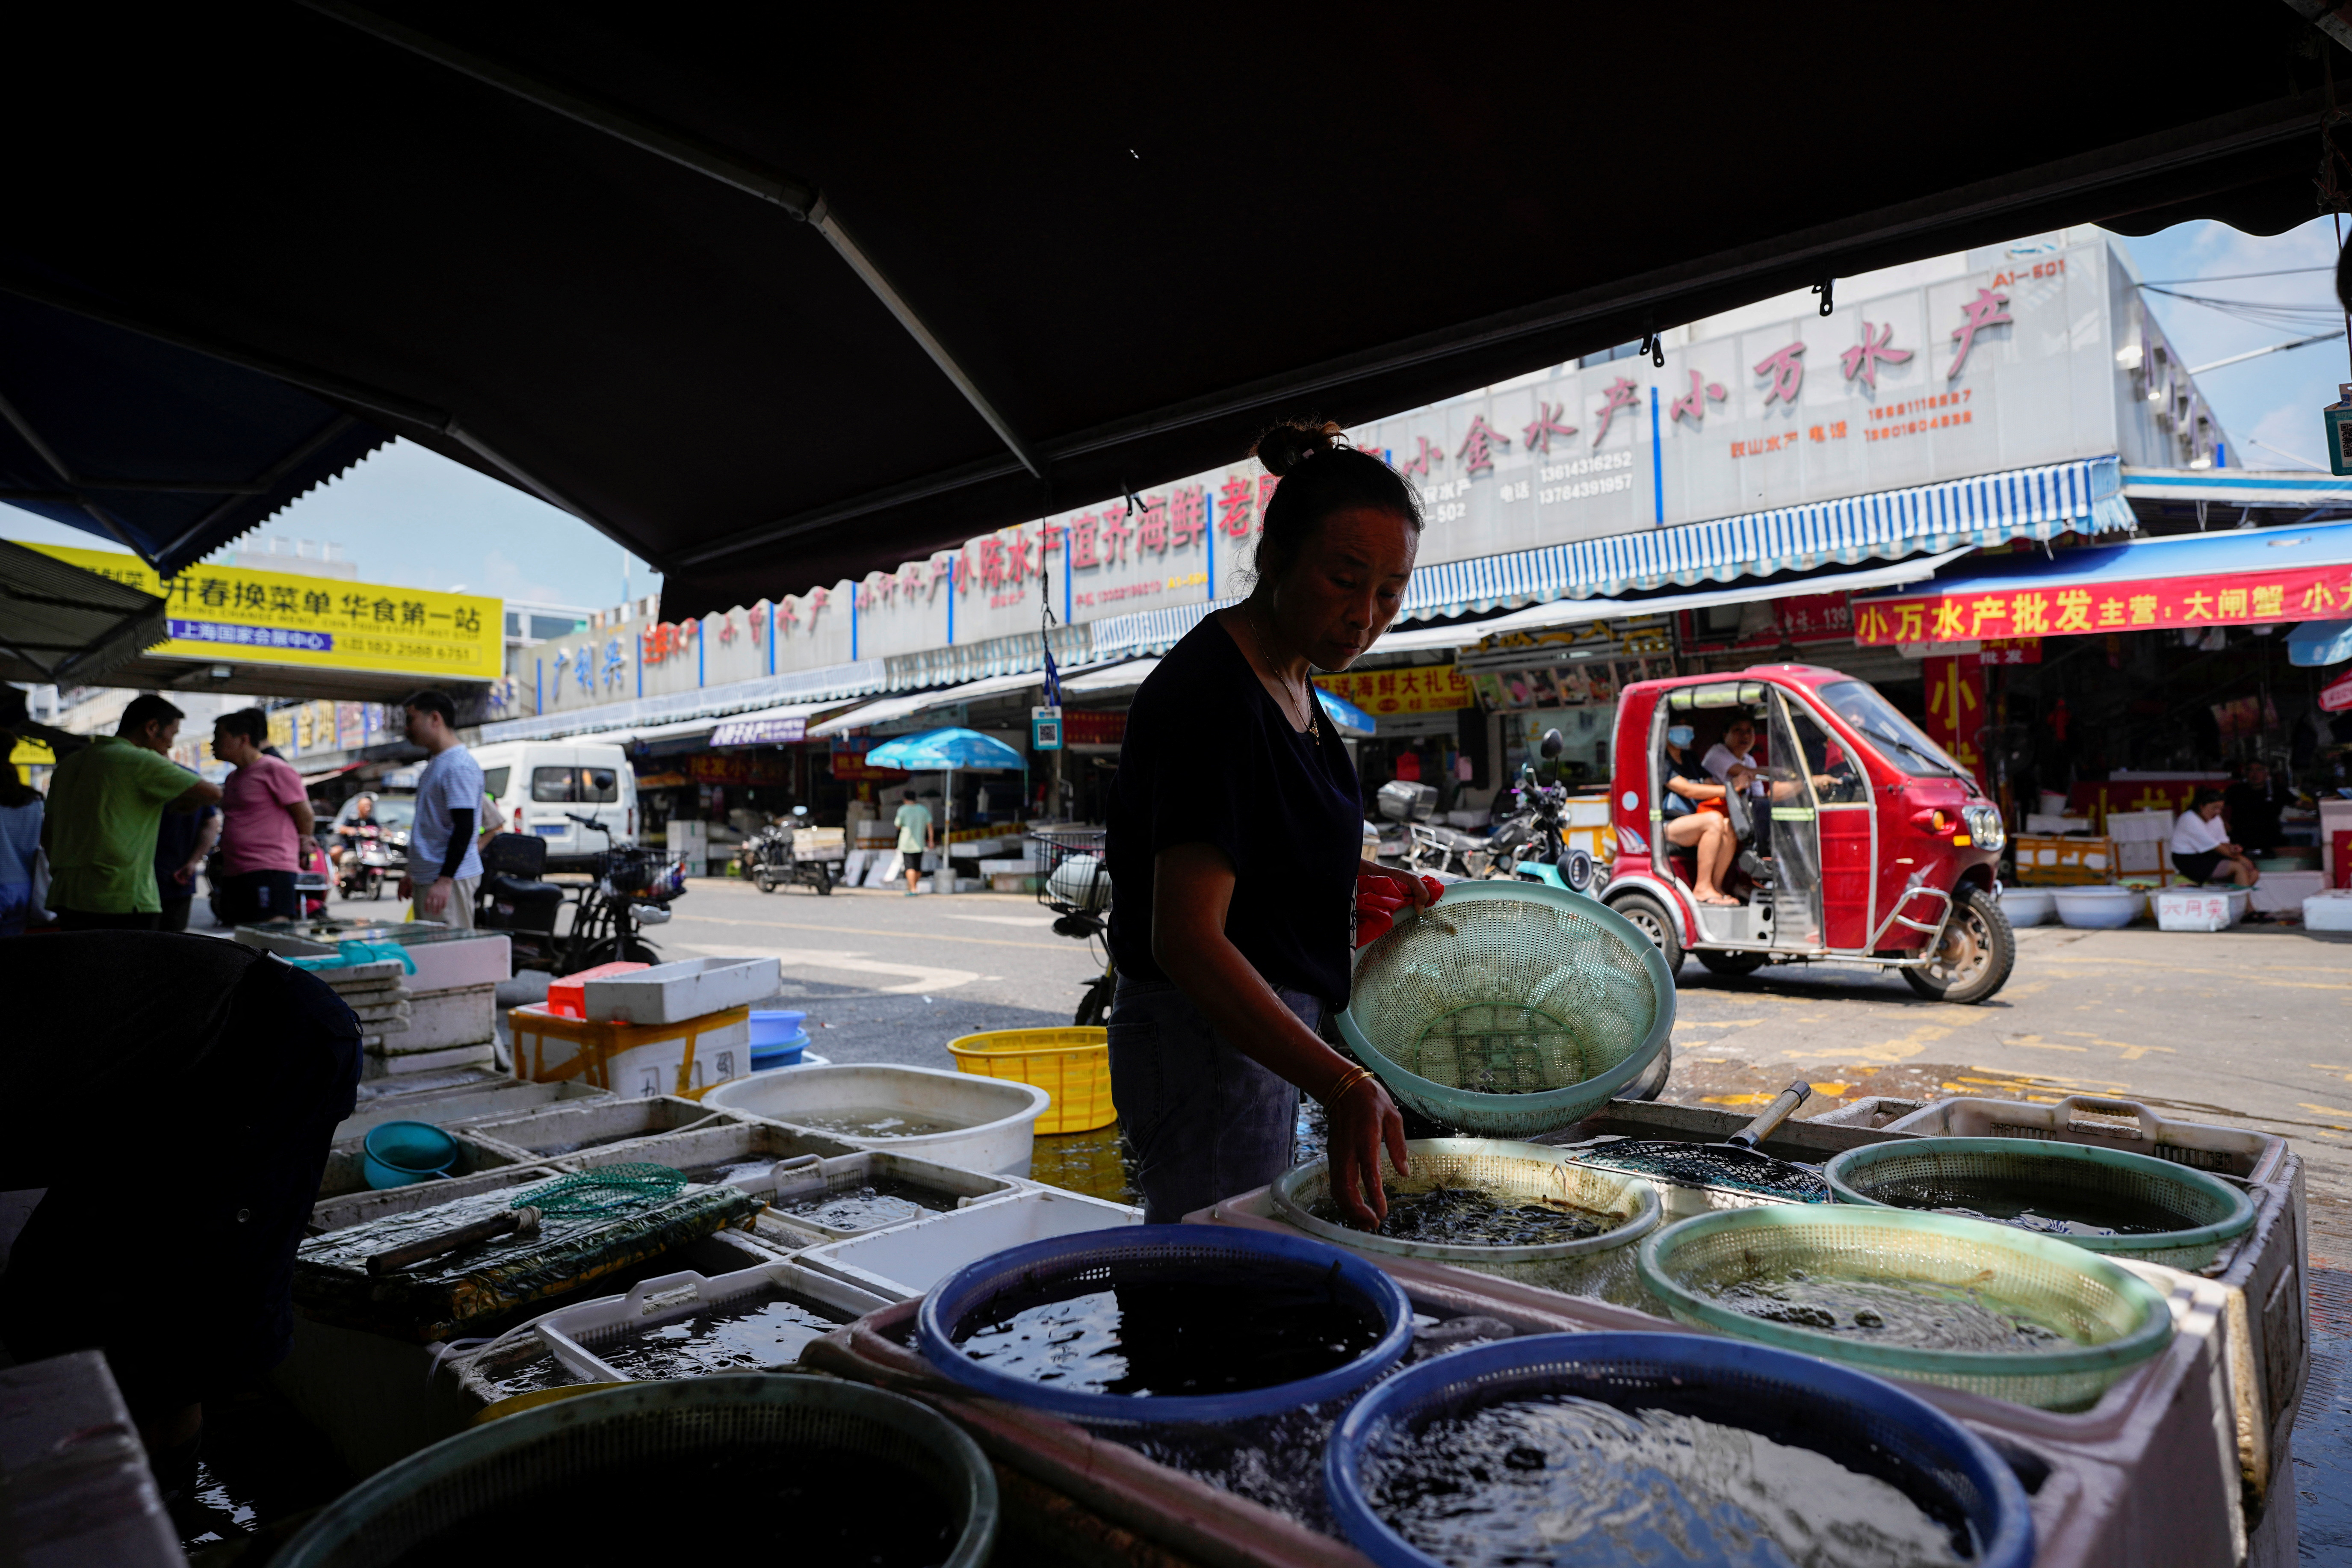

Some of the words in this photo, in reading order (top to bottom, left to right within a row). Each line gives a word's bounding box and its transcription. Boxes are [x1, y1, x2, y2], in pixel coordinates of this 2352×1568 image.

[1670, 288, 2011, 422] 小万水产
[1403, 377, 1640, 475] 小金水产
[1499, 479, 1531, 503] 电话
[951, 523, 1061, 593] 小陈水产
[166, 576, 331, 616] 开春换菜单
[340, 593, 482, 633] 华食第一站
[1859, 589, 2093, 643] 小万水产批发
[180, 620, 325, 651] 上海国家会展中心
[1980, 649, 2023, 663] 批发
